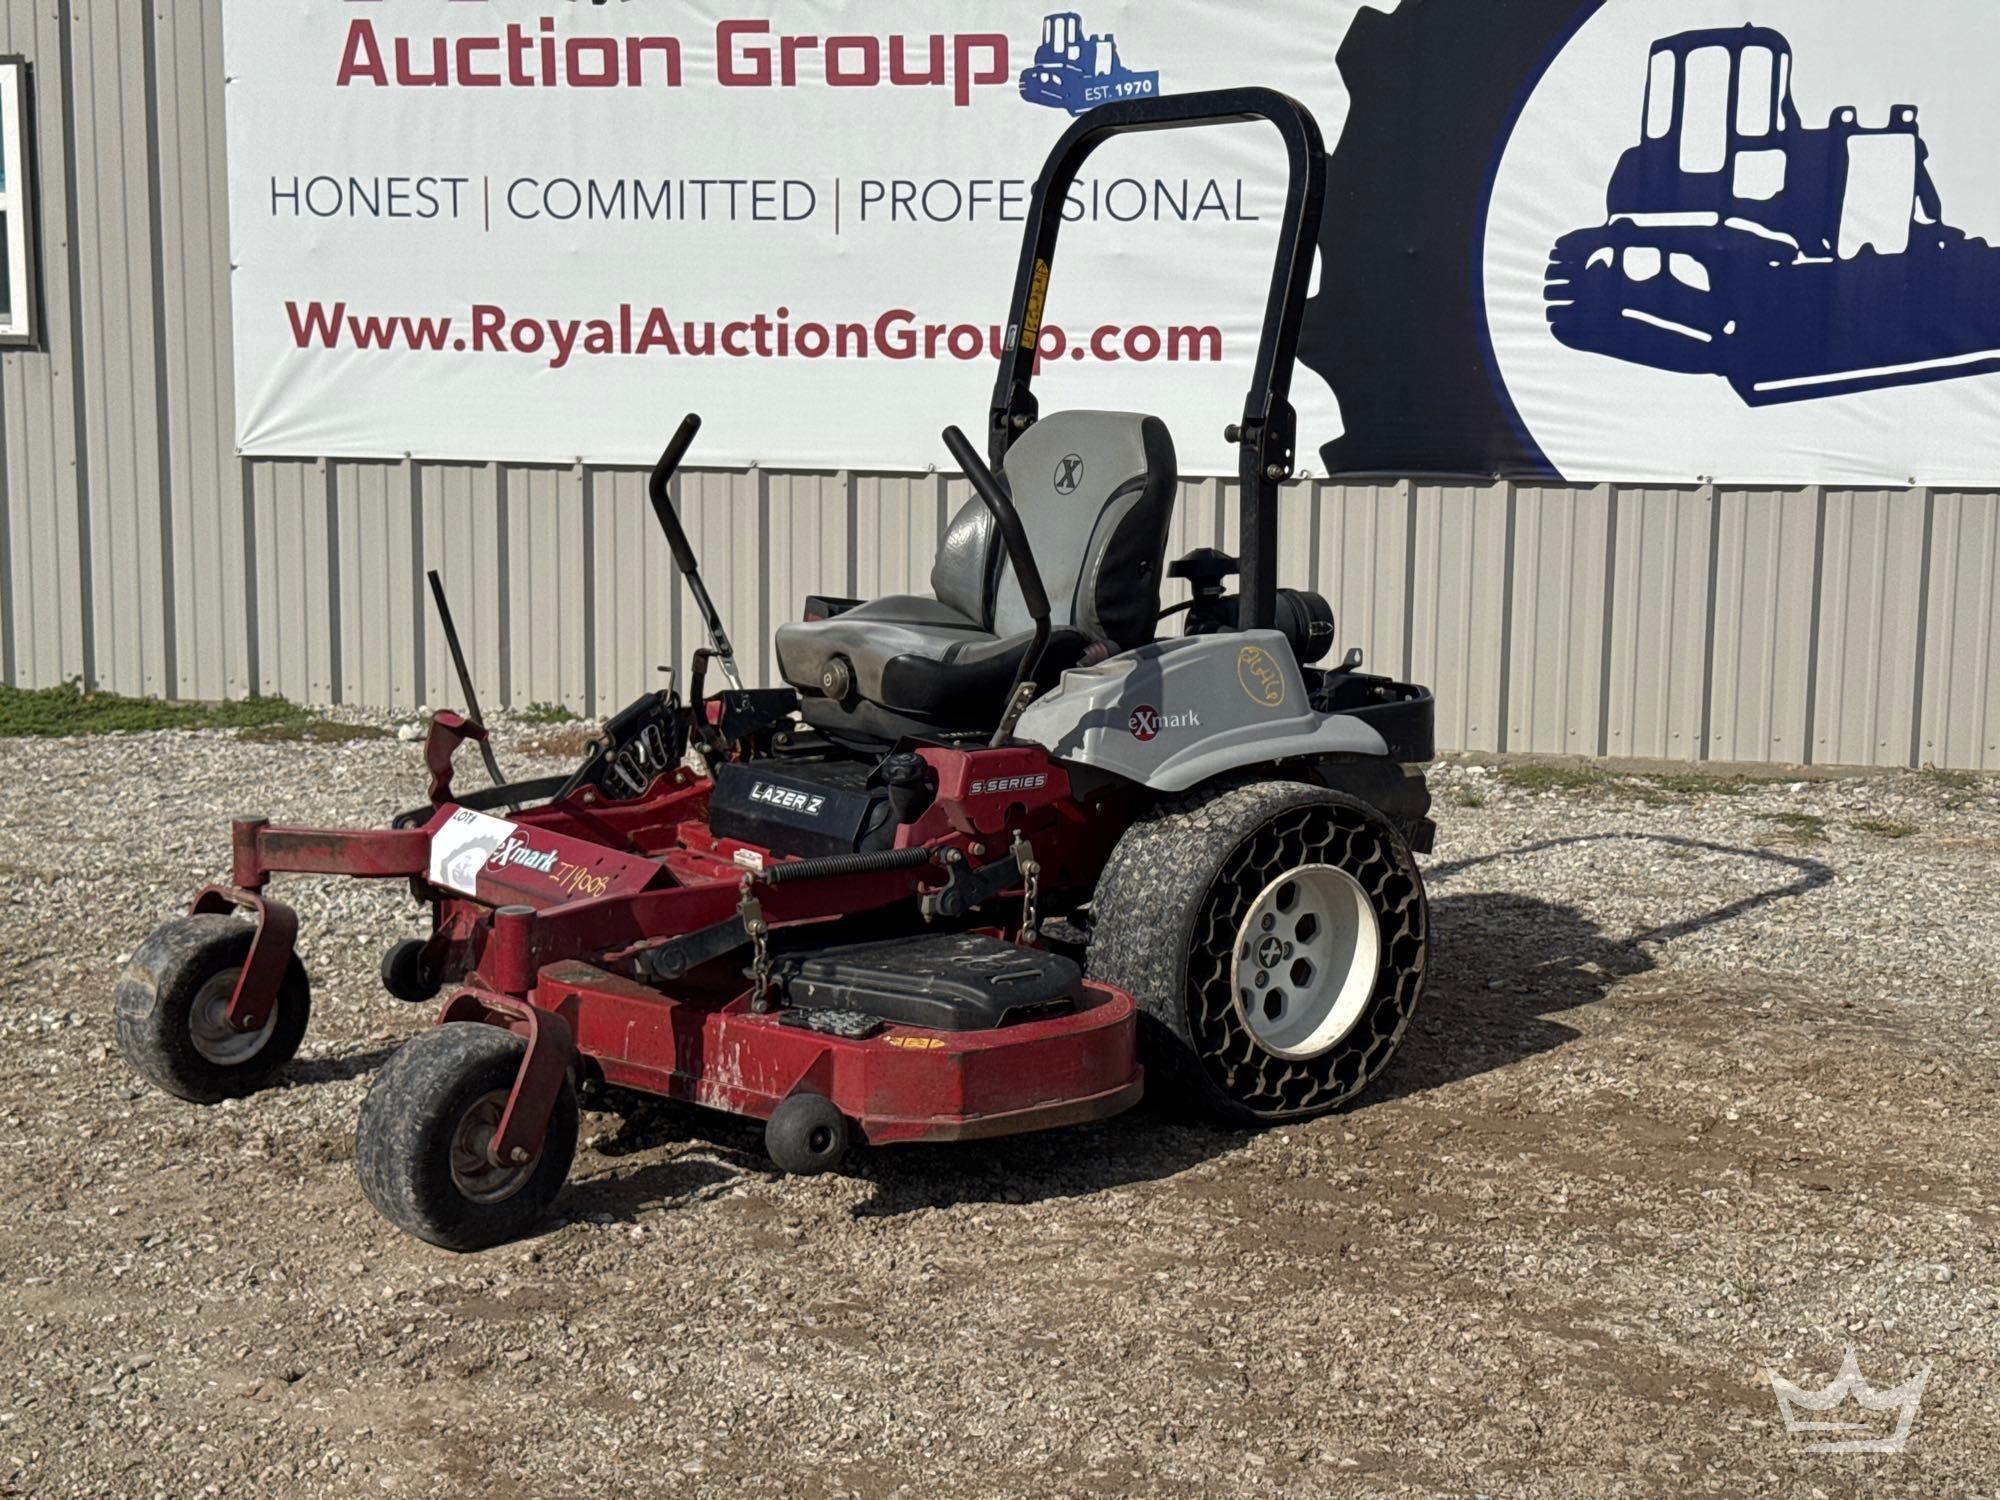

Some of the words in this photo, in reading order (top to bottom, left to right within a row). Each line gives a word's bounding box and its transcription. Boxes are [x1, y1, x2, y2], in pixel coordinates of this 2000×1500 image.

[336, 17, 682, 87] Auction
[716, 20, 1009, 106] Group
[1085, 85, 1112, 101] EST.
[1115, 79, 1152, 97] 1970
[271, 176, 469, 218] HONEST
[507, 178, 816, 220] COMMITTED
[860, 178, 1260, 222] PROFESIONAL
[750, 782, 809, 811] LAZER
[806, 797, 825, 814] Z
